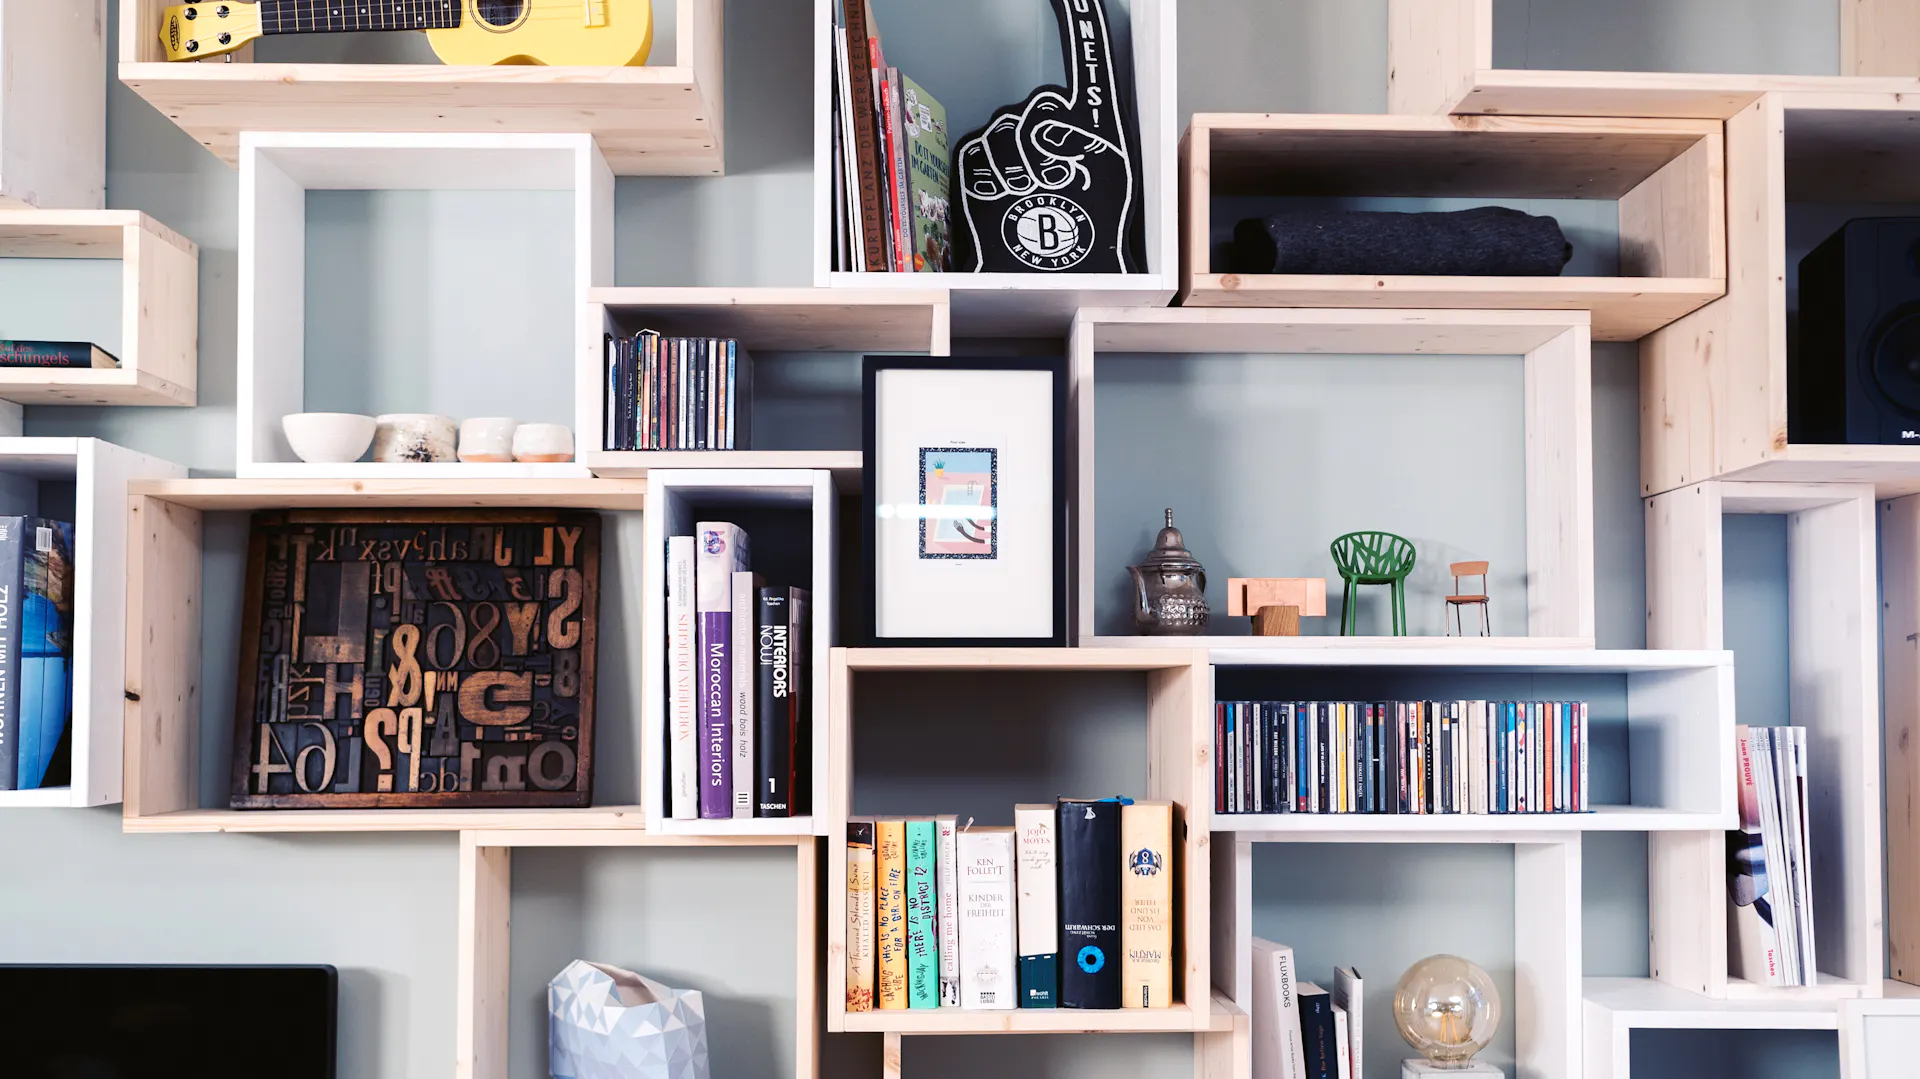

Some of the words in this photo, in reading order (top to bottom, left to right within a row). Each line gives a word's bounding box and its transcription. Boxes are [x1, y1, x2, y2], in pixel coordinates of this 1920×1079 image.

[1079, 20, 1103, 128] NETS!
[858, 124, 872, 149] DIE
[914, 140, 922, 157] DO
[923, 147, 928, 160] IT
[911, 154, 920, 172] IM
[920, 160, 939, 184] GARTEN
[861, 160, 877, 221] PFLANZ
[1008, 197, 1086, 222] BROOKLYN
[1038, 214, 1059, 250] B
[864, 226, 880, 268] KURT
[1012, 244, 1042, 265] NEW
[1051, 246, 1086, 268] YORK
[738, 593, 748, 646] architecture
[678, 613, 689, 672] DELIGHTS
[760, 625, 773, 666] NOW!
[738, 648, 748, 688] materials
[773, 625, 787, 698] INTERIORS
[710, 644, 725, 718] Moroccan
[678, 675, 689, 741] NORTHERN
[738, 692, 748, 716] wood
[738, 718, 748, 736] bois
[710, 722, 725, 786] Interiors
[738, 740, 748, 758] holz
[1740, 738, 1748, 756] Jean
[1743, 758, 1754, 786] PROUVÉ
[768, 778, 776, 794] 1
[1027, 829, 1046, 837] JOJO
[1142, 852, 1150, 864] 8
[848, 863, 859, 884] Suns
[890, 868, 900, 886] FIRE
[914, 866, 928, 877] 12
[967, 866, 1004, 876] FOLLETT
[849, 888, 862, 926] Splendid
[880, 886, 889, 910] PLACE
[892, 890, 902, 900] ON
[909, 898, 920, 910] NO
[918, 881, 933, 920] DISTRICT
[943, 892, 952, 918] home
[968, 894, 1004, 902] KINDER
[880, 916, 889, 927] NO
[892, 904, 902, 922] GIRL
[909, 916, 919, 924] IS
[966, 909, 1005, 917] FREIHEIT
[946, 922, 953, 936] me
[883, 945, 894, 964] THIS
[893, 938, 904, 952] FOR
[912, 930, 927, 958] THERE
[944, 939, 954, 972] calling
[1129, 948, 1162, 959] MARTIN
[852, 966, 860, 976] A
[1768, 948, 1776, 976] Taschen
[881, 969, 894, 1002] CATCHING
[892, 974, 903, 990] FIRE
[915, 963, 929, 1001] MOCKINGJAY
[1279, 955, 1291, 1008] FLUXBOOKS
